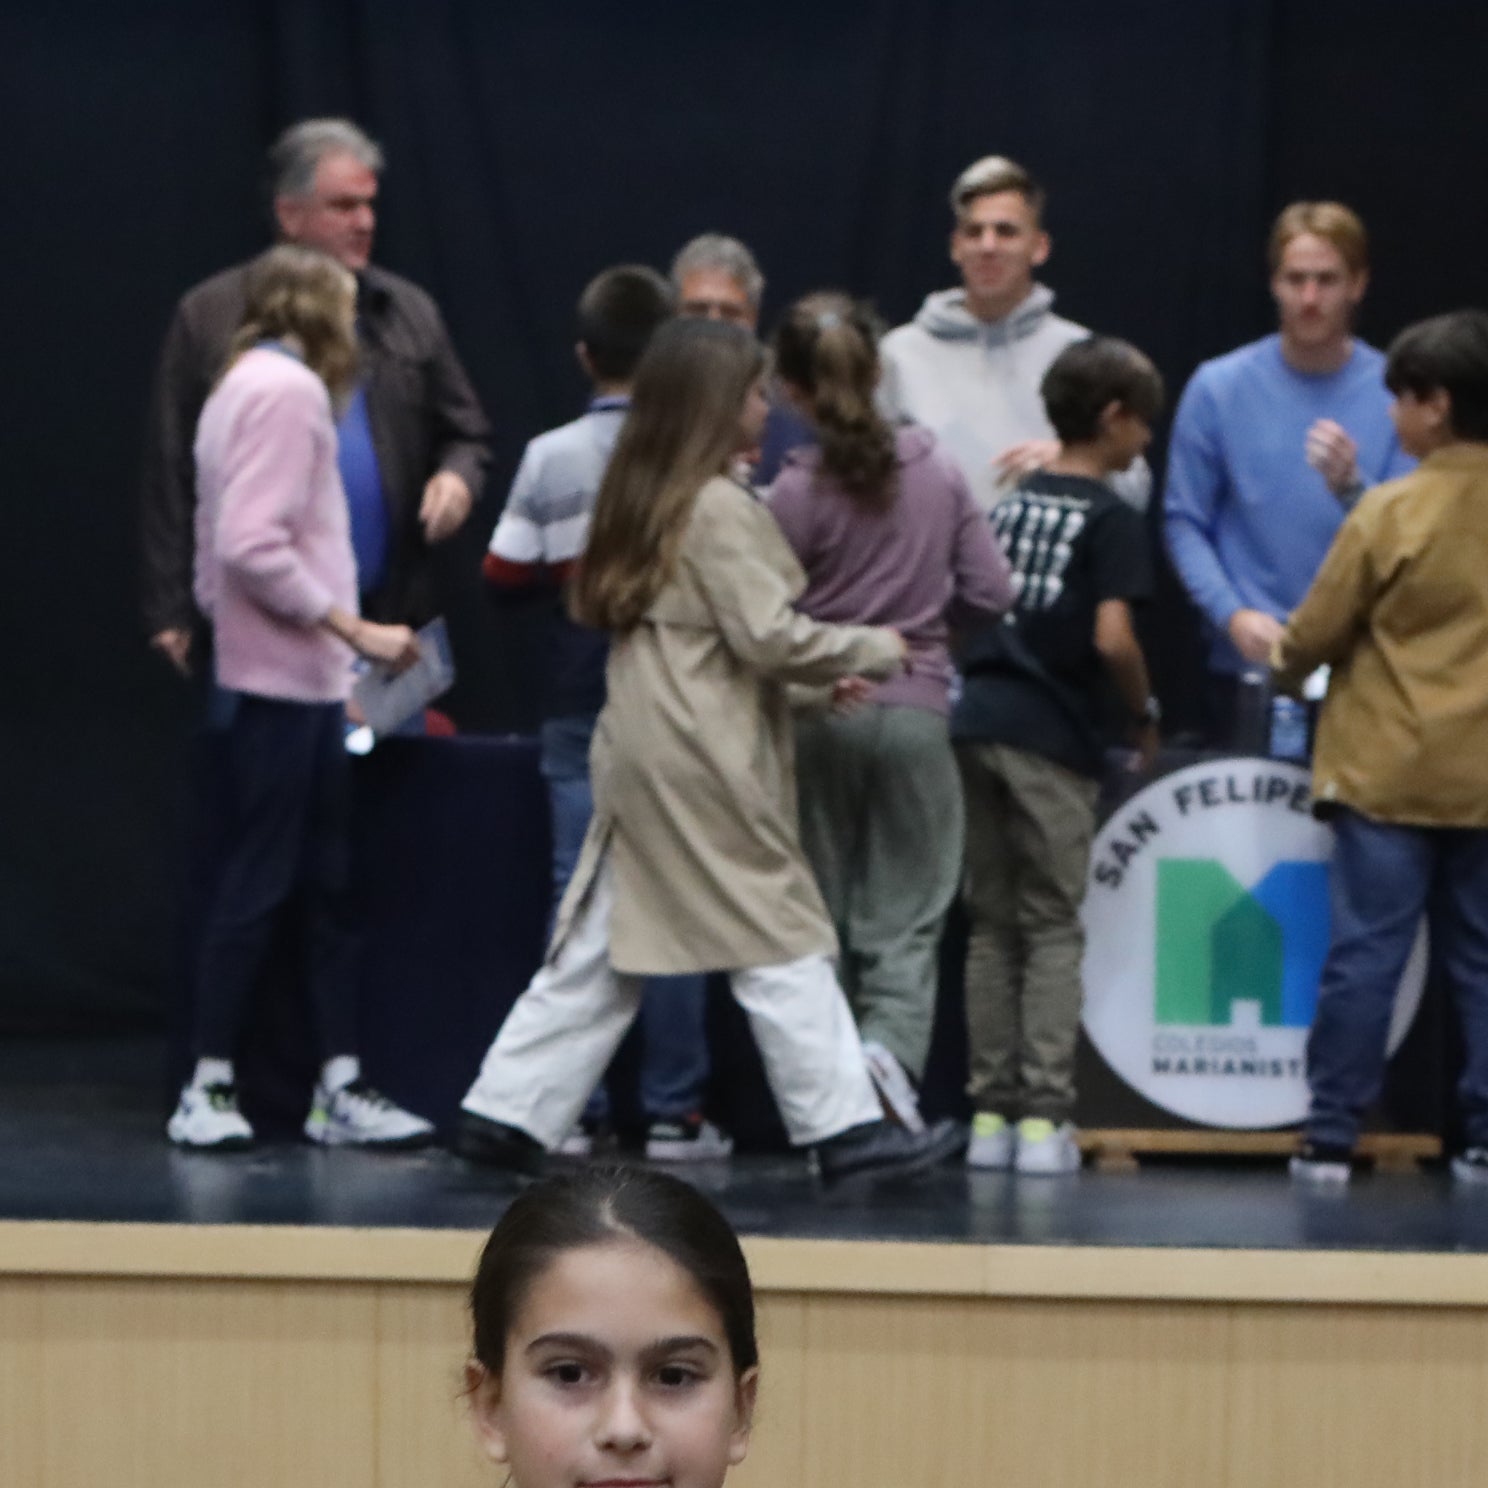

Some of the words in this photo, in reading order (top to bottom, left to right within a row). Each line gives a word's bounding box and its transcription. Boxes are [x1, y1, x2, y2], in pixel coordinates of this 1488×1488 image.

[1094, 811, 1160, 889] SAN
[1173, 774, 1311, 816] FELIPE
[1153, 1034, 1256, 1052] COLEGIOS
[1153, 1057, 1302, 1076] MARIANIST
